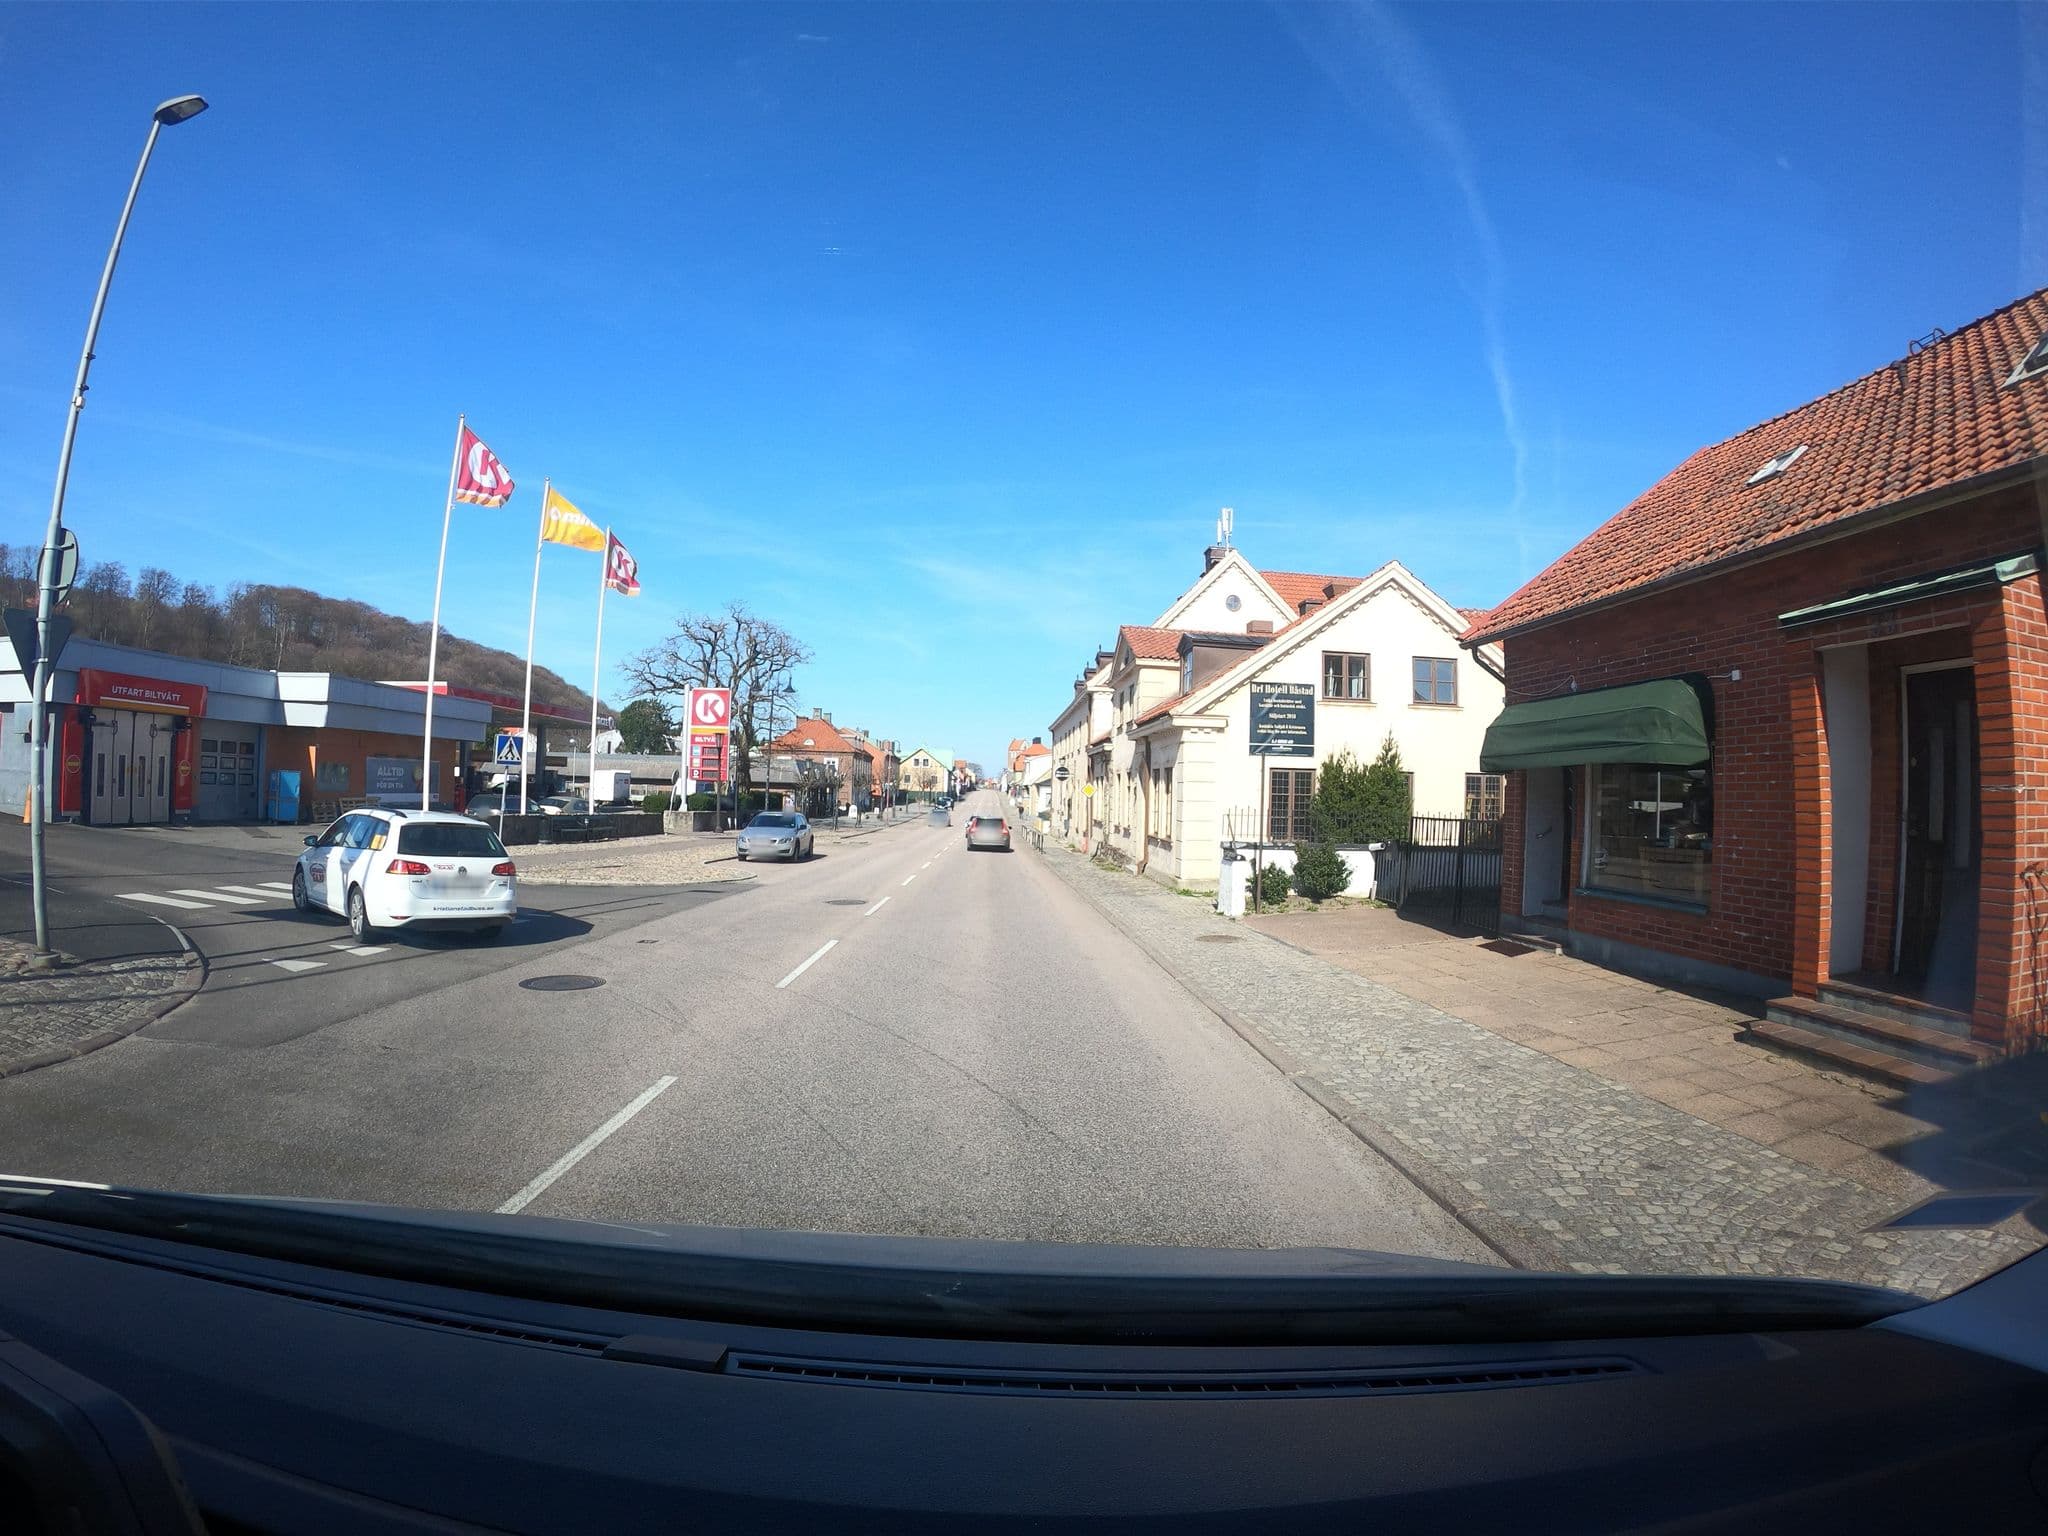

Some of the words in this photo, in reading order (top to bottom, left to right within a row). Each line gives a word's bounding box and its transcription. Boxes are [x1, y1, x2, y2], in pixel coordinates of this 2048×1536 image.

[112, 685, 144, 697] UTFART
[1289, 684, 1313, 695] Båstad
[377, 766, 404, 777] ALLTID
